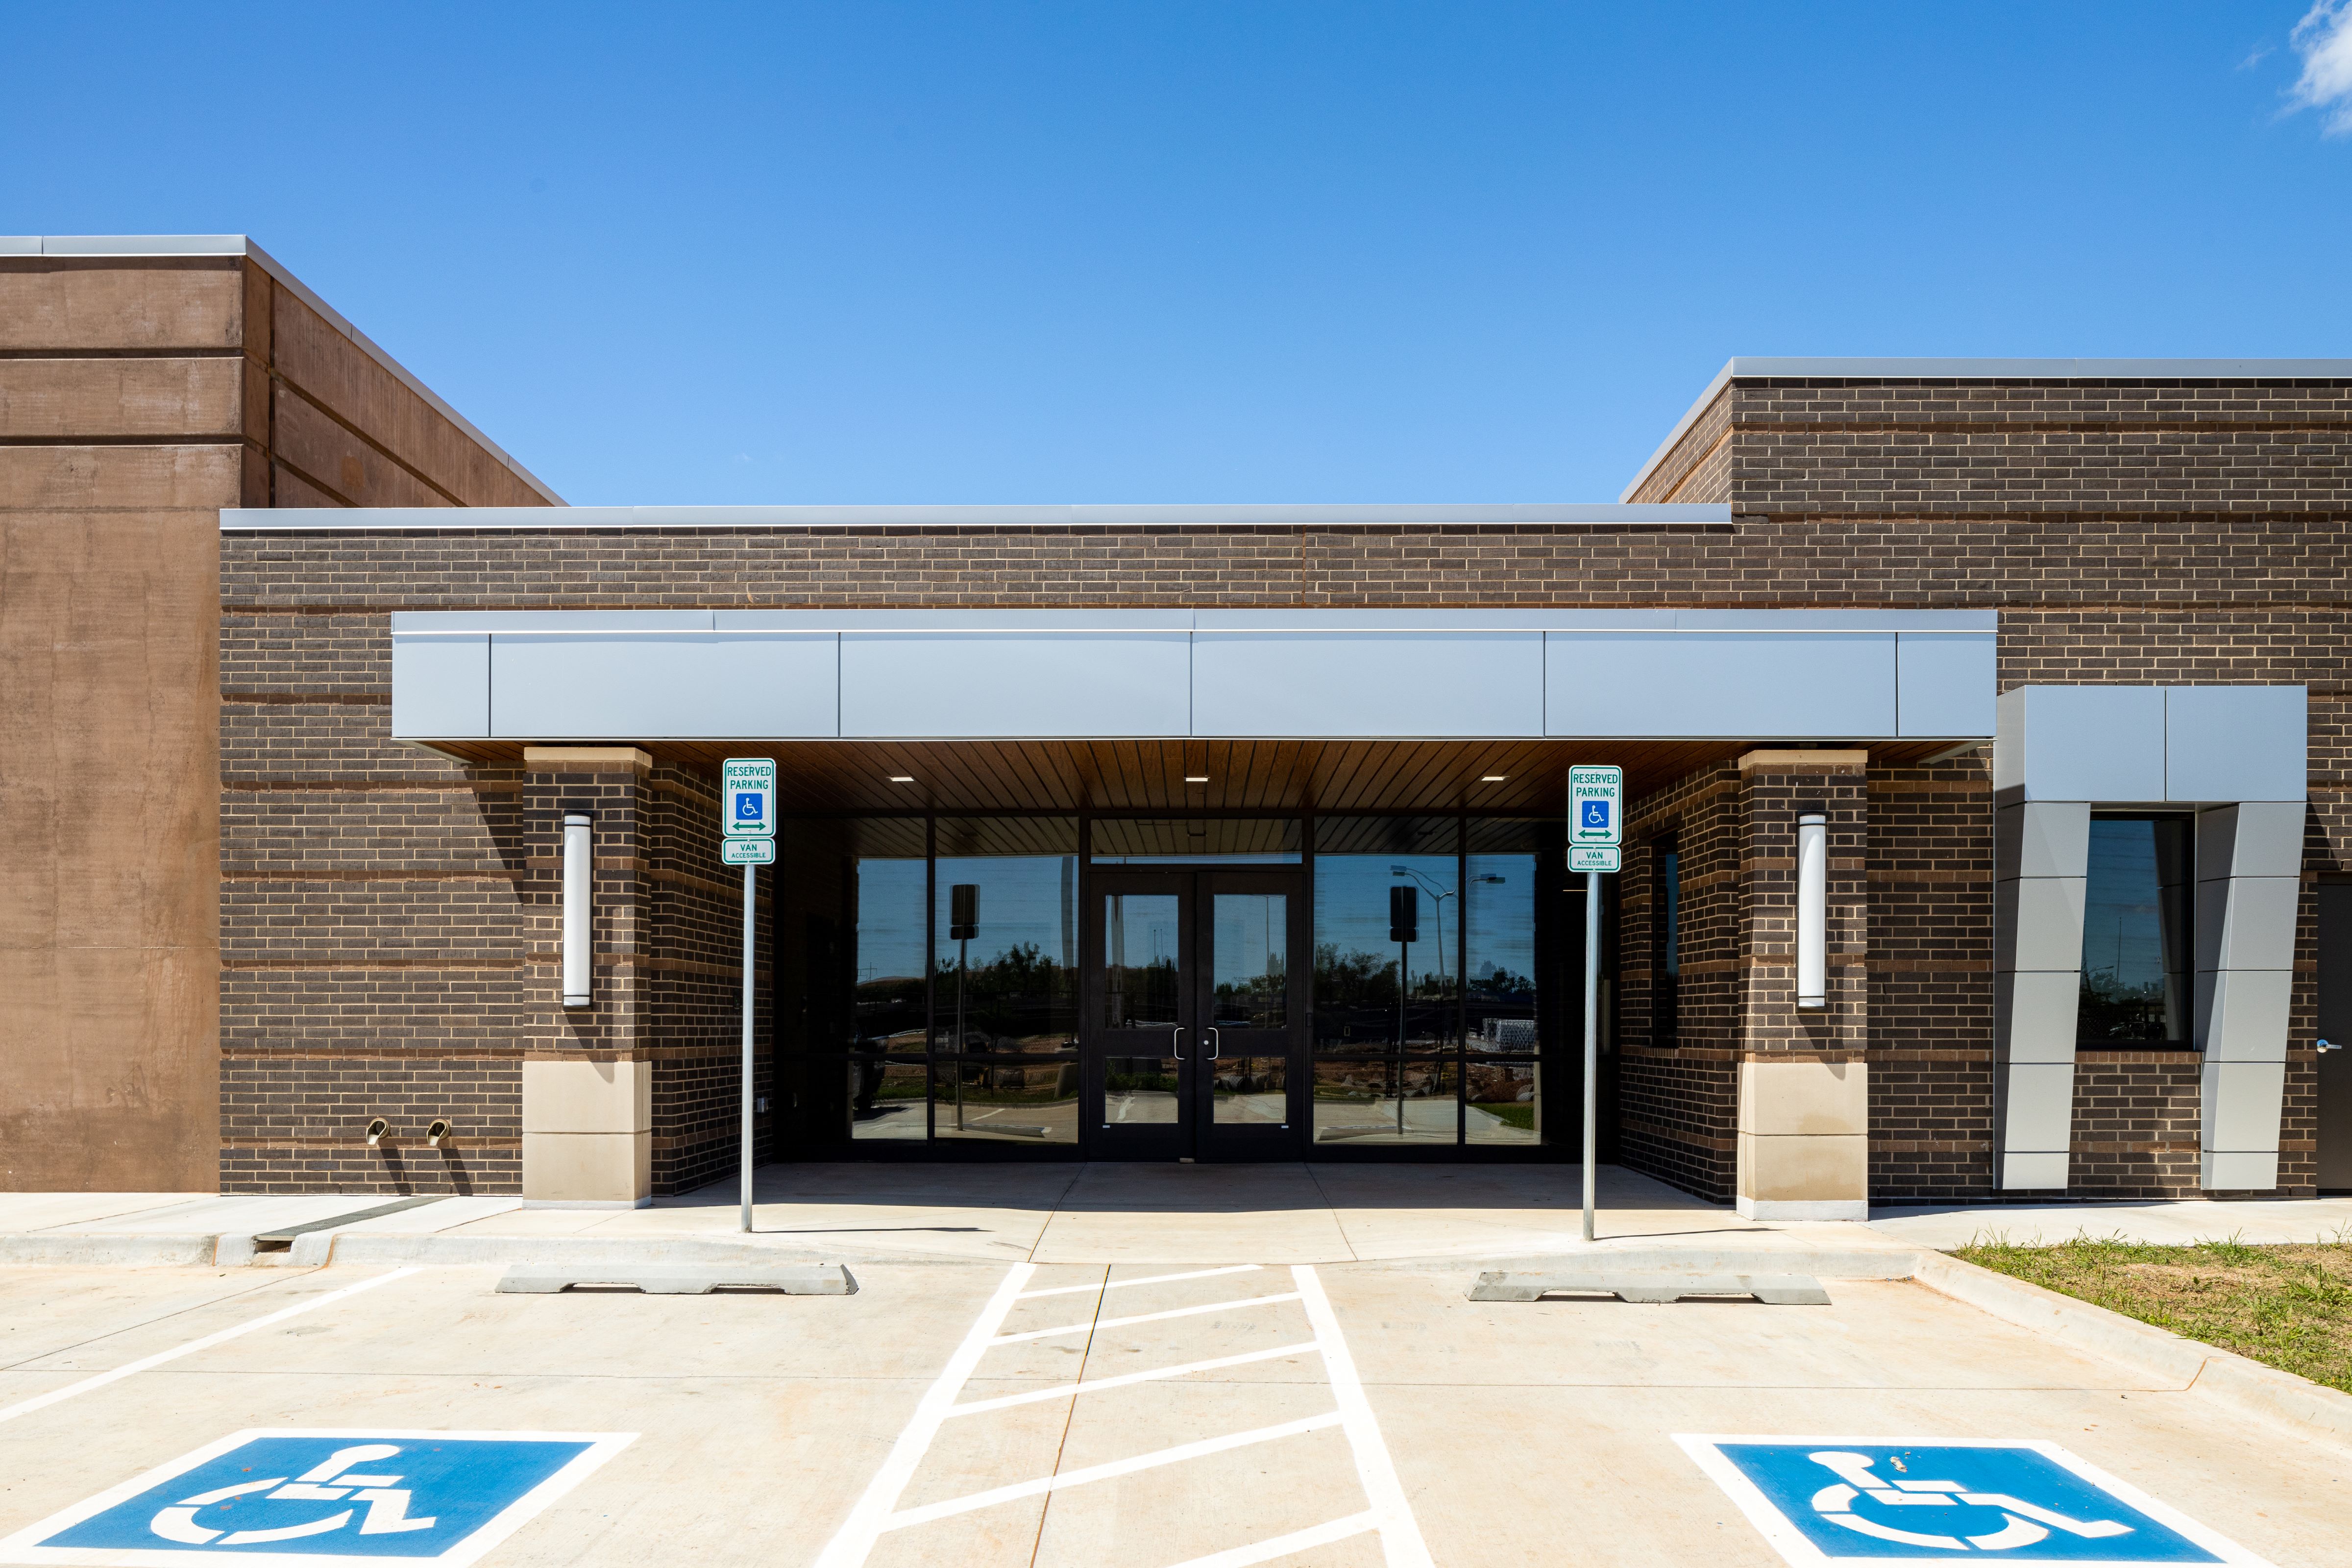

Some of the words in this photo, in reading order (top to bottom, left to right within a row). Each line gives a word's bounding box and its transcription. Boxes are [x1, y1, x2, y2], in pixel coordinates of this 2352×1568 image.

[727, 766, 772, 776] RESERVED
[1573, 774, 1618, 784] RESERVED
[730, 780, 768, 789] PARKING
[1576, 787, 1615, 797] PARKING
